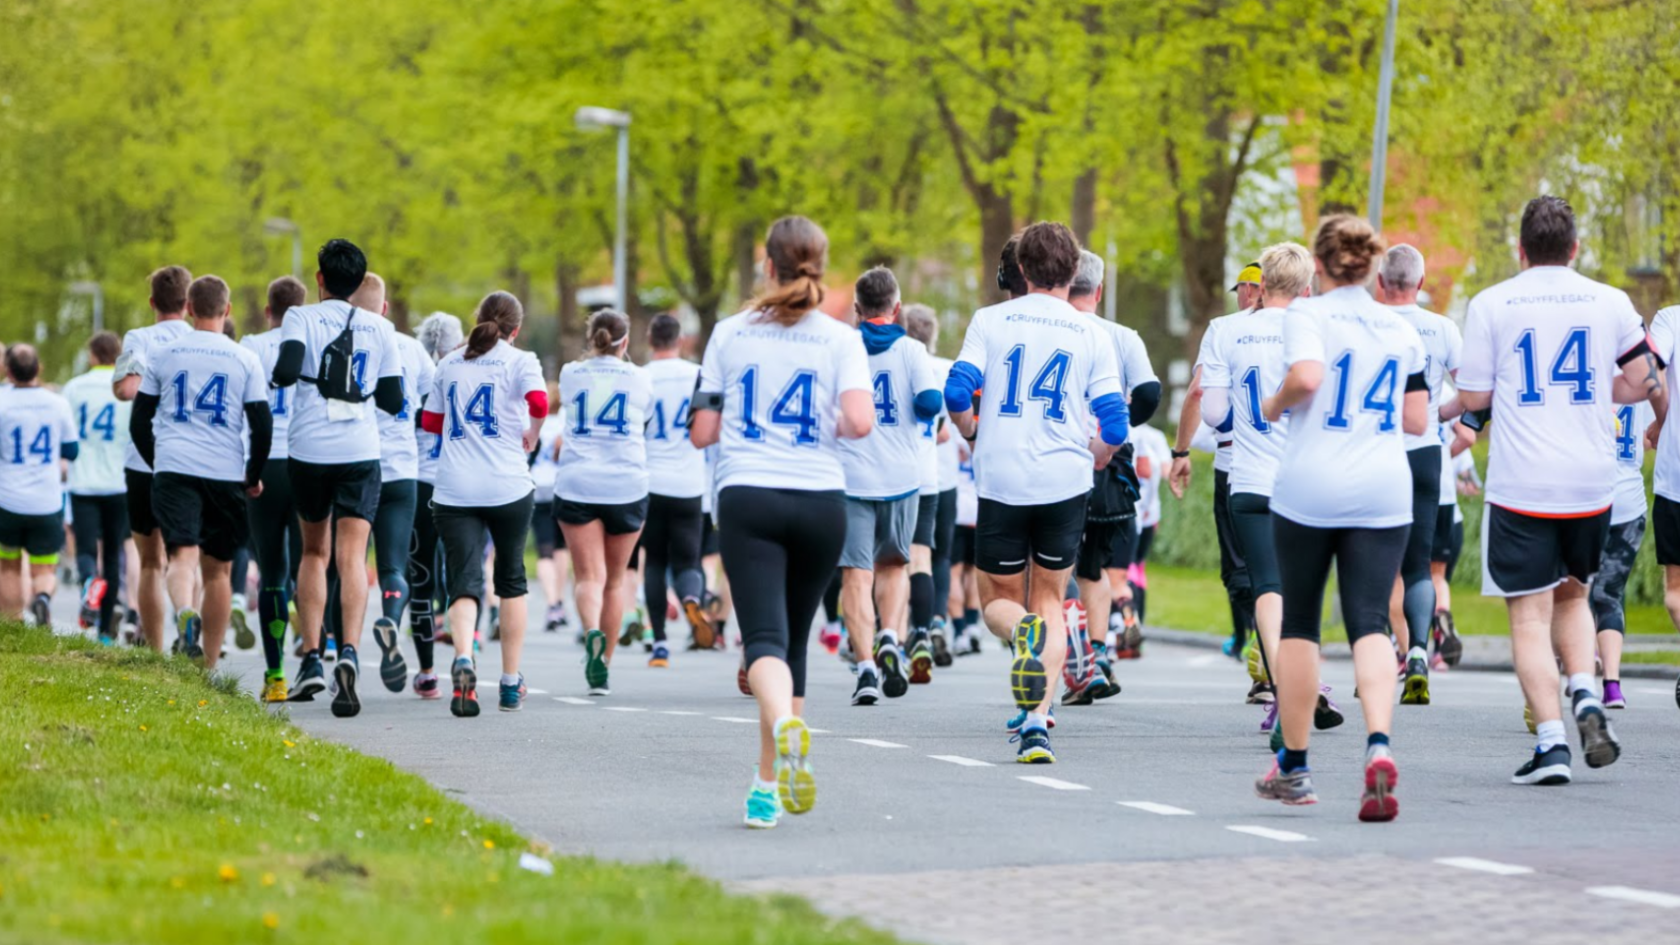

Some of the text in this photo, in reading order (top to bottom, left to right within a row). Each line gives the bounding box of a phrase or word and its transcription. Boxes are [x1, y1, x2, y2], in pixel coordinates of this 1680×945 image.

[1006, 314, 1086, 334] #CRUYFFLEGACY
[1506, 294, 1597, 305] #CRUYFFLEGACY
[1236, 335, 1284, 345] #CRUYFFL
[1514, 326, 1596, 407] 14
[170, 370, 229, 427] 14
[447, 381, 500, 440] 14
[737, 364, 820, 448] 14
[872, 370, 899, 427] 4
[998, 343, 1074, 424] 14
[1323, 348, 1401, 435] 14
[78, 401, 114, 441] 14
[572, 389, 630, 438] 14
[1616, 404, 1637, 462] 4
[10, 425, 52, 464] 14
